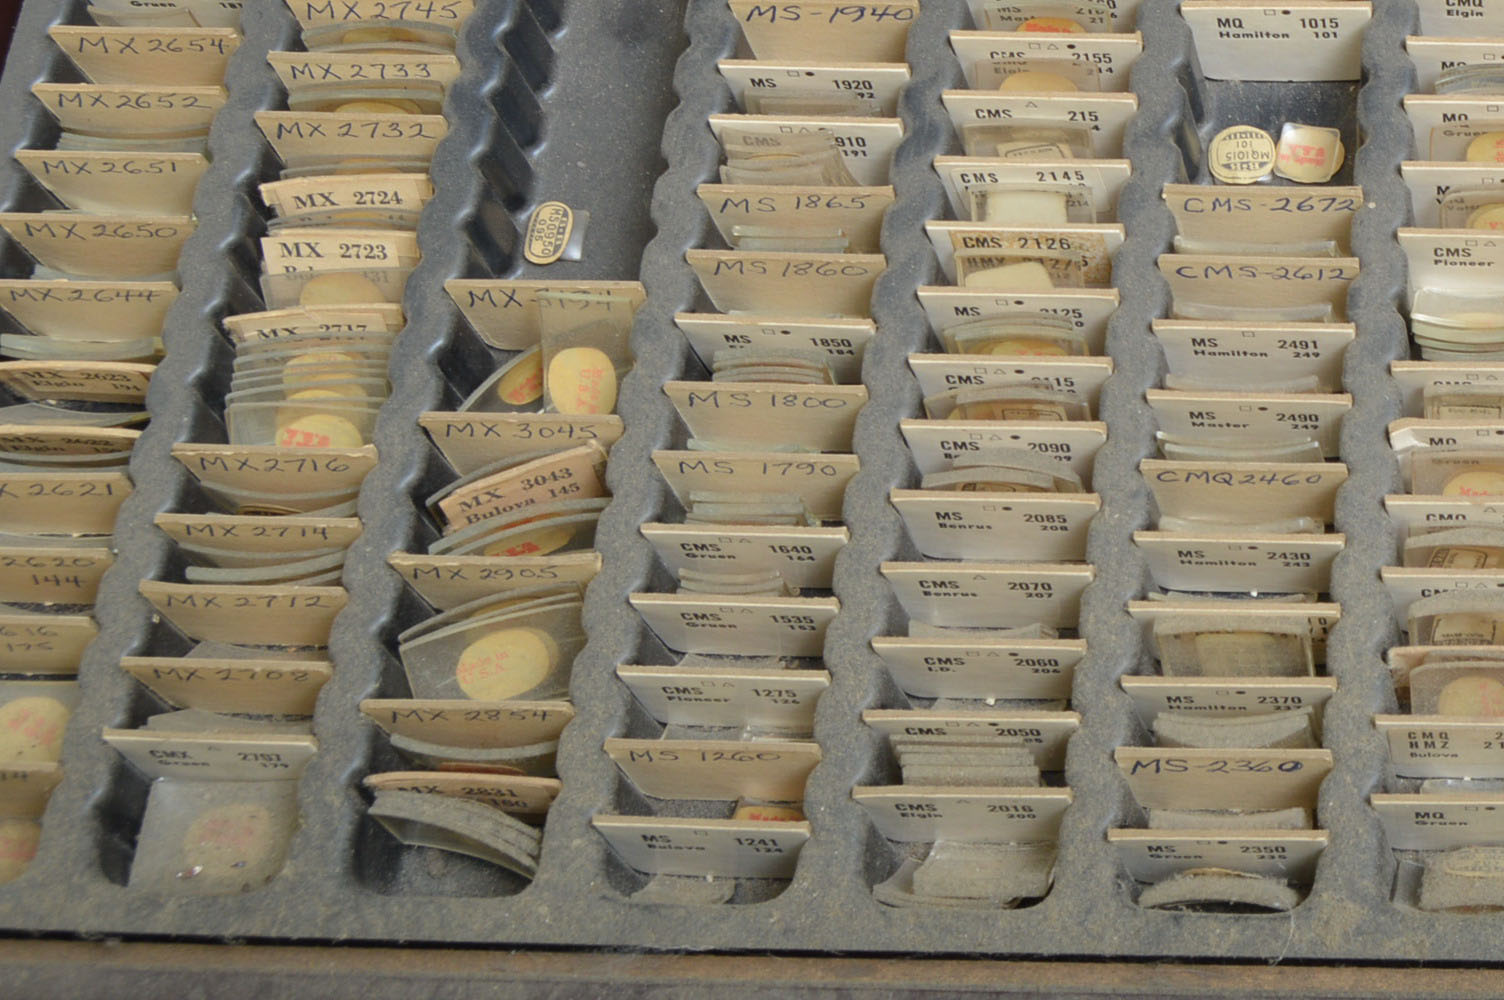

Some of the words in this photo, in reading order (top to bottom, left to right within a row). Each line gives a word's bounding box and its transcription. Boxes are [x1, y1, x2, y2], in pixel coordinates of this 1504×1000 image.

[1217, 18, 1244, 29] MQ
[1300, 18, 1338, 28] 1015
[750, 78, 776, 87] MS
[833, 80, 872, 90] 1920
[975, 109, 1012, 118] CMS
[1068, 111, 1098, 121] 215
[960, 173, 998, 183] CMS
[1036, 170, 1084, 181] 2145
[293, 192, 339, 209] MX
[353, 191, 403, 205] 2724
[279, 242, 324, 258] MX
[339, 243, 387, 260] 2723
[1434, 248, 1471, 257] CMS
[810, 338, 852, 347] 1850
[1192, 338, 1218, 347] MS
[1278, 340, 1317, 349] 2491
[1024, 514, 1067, 523] 2085
